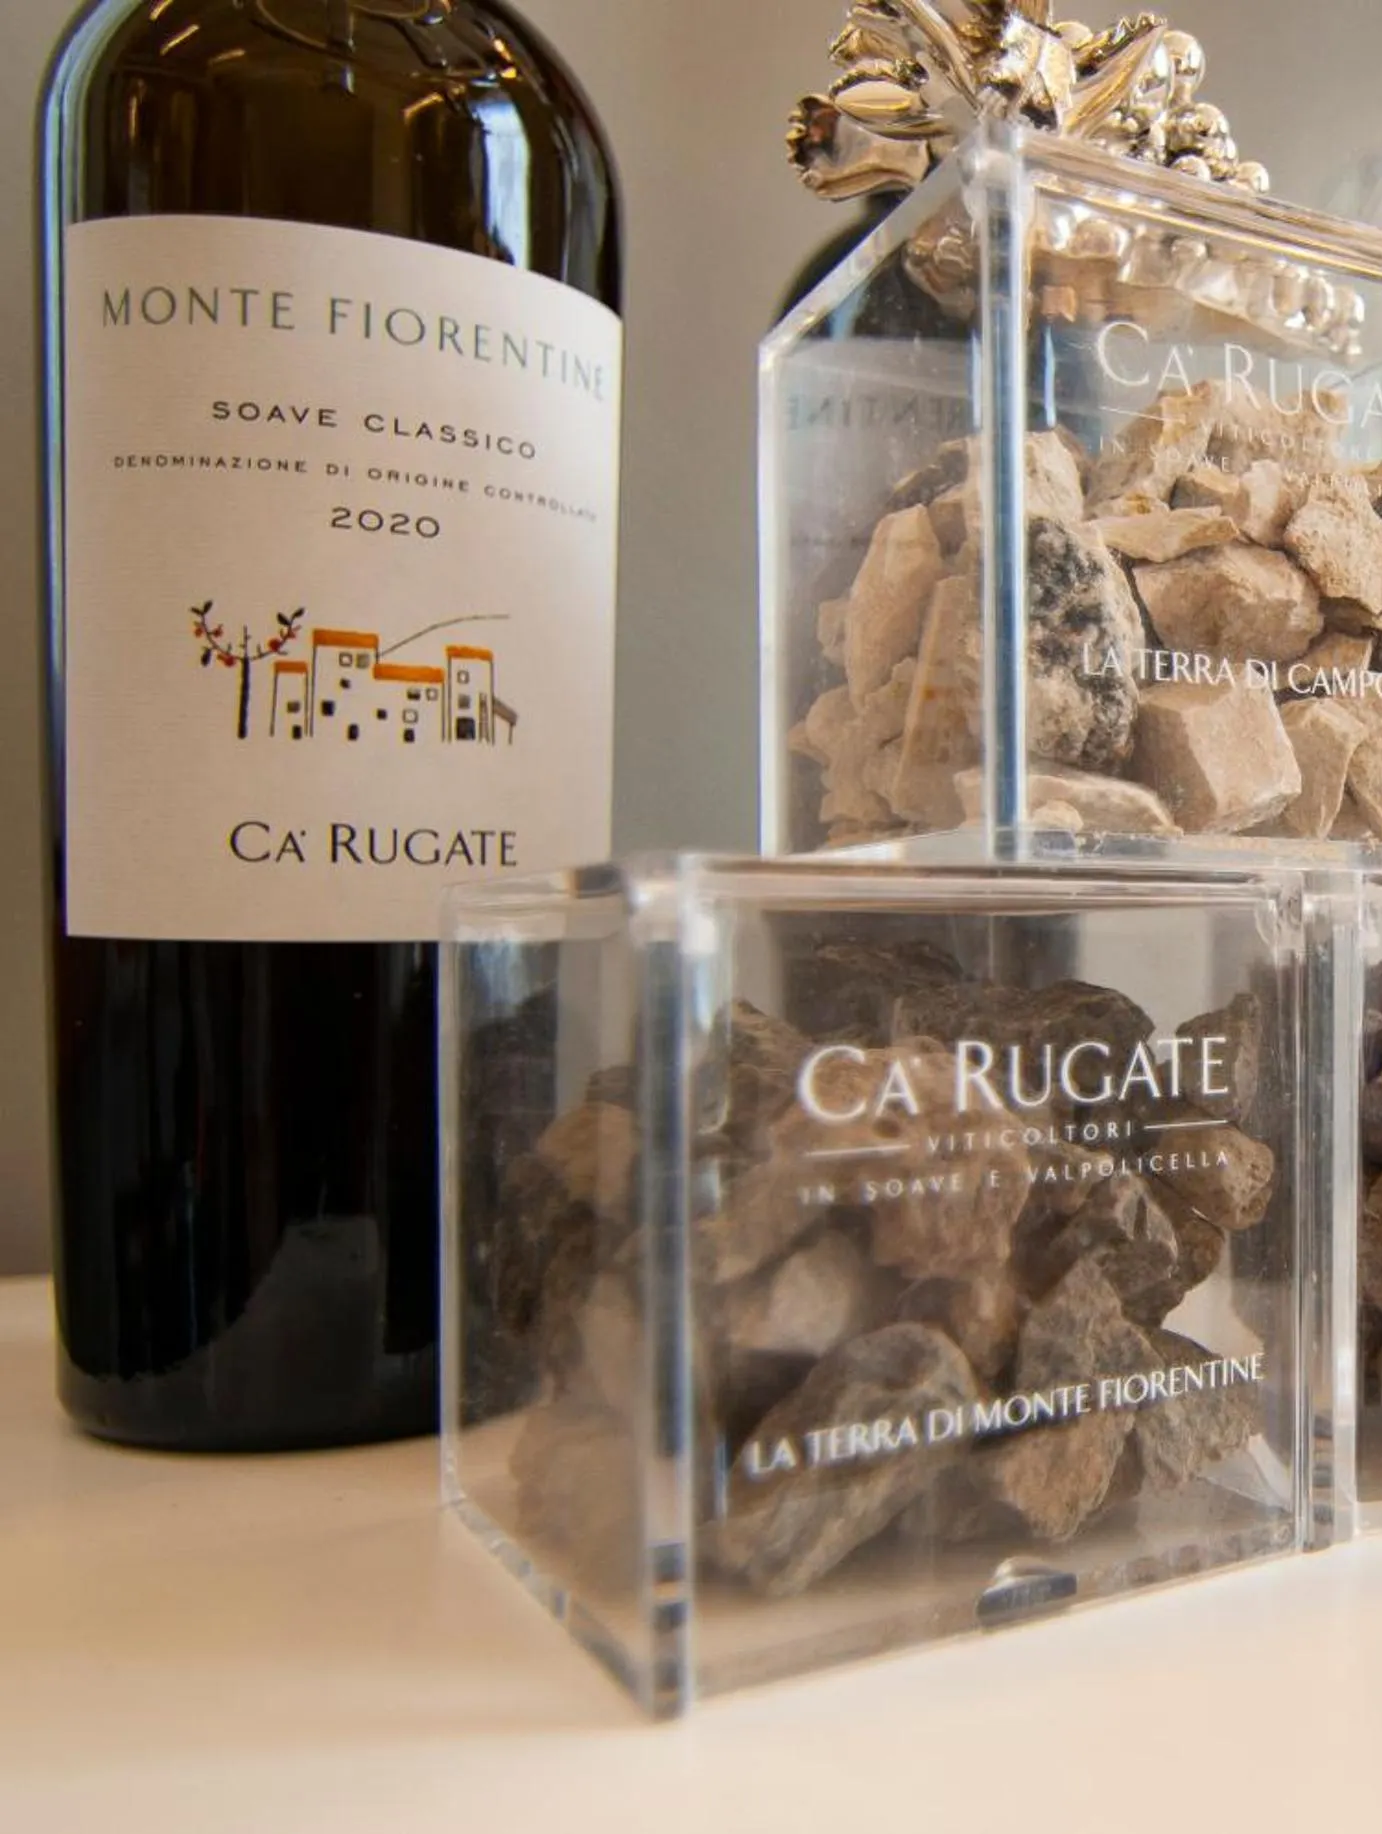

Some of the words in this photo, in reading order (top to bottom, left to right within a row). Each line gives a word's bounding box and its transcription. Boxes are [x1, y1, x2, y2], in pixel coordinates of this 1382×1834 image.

[102, 285, 296, 331] MONTE
[329, 296, 606, 401] FIORENTINE
[211, 400, 338, 428] SOAVE
[364, 413, 538, 460] CLASSICO
[114, 455, 308, 474] DENOMINAZIONE
[325, 462, 350, 478] DI
[367, 467, 470, 493] ORIGINE
[330, 506, 441, 539] 2020
[1082, 642, 1124, 678] LA
[1132, 647, 1236, 688] TERRA
[1245, 659, 1278, 691] DI
[329, 822, 518, 868] RUGATE
[955, 1036, 1230, 1112] RUGATE
[926, 1121, 1133, 1153] VITICOLTORI
[801, 1186, 836, 1206] IN
[867, 1173, 963, 1203] SOAVE
[990, 1168, 1001, 1189] E
[1025, 1150, 1231, 1184] VALPOLICELLA
[747, 1437, 799, 1476] LA
[804, 1420, 919, 1468] TERRA
[926, 1408, 964, 1443] DI
[972, 1383, 1092, 1435] MONTE
[1099, 1352, 1265, 1411] FIORENTINE
